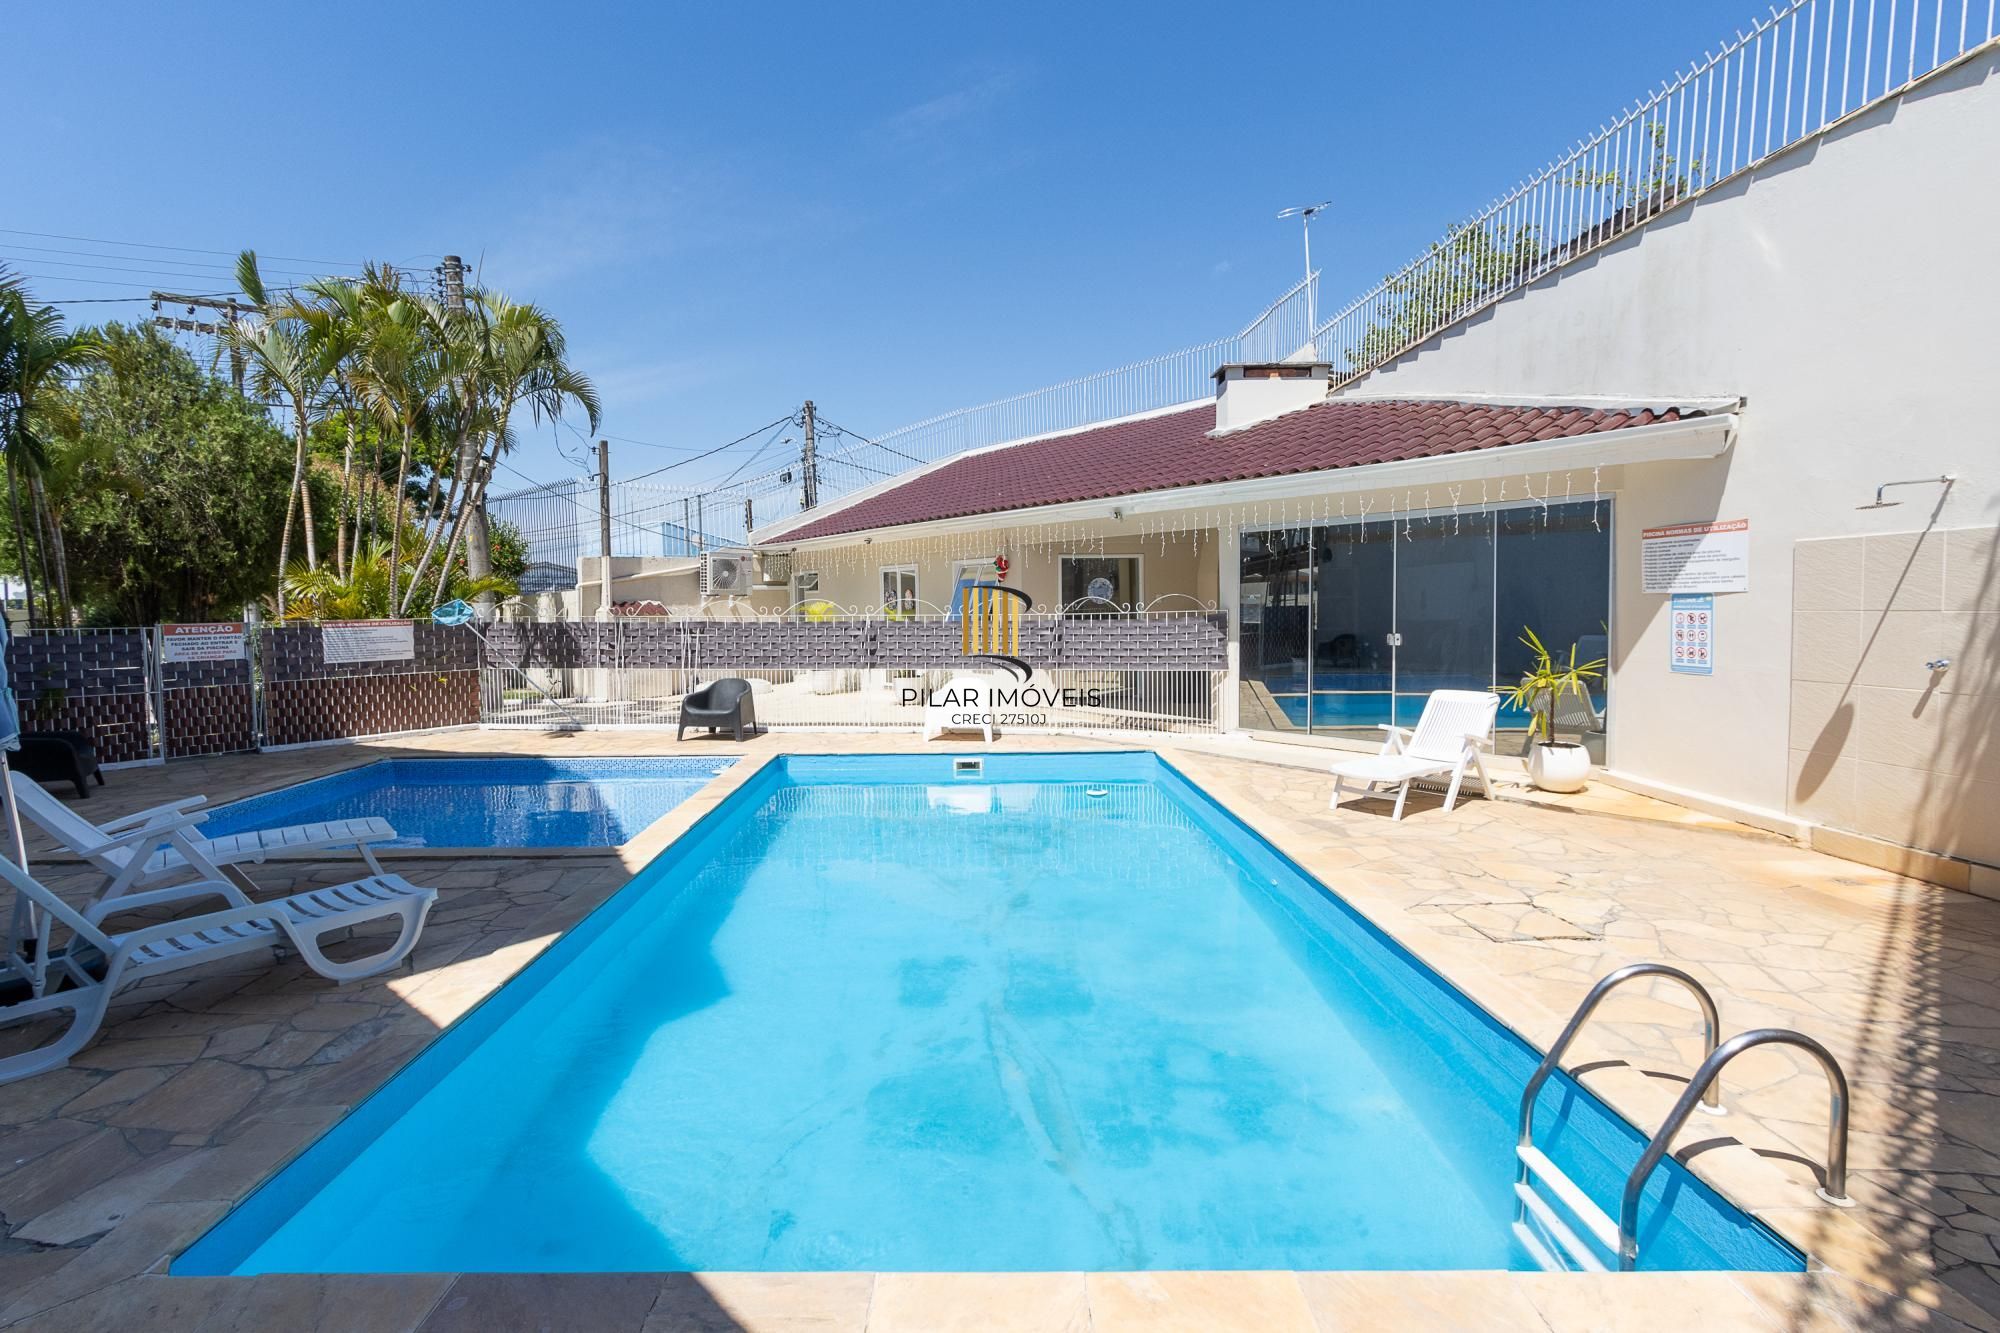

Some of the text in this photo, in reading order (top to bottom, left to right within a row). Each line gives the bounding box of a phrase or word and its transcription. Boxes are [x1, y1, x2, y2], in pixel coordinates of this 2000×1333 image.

[1665, 528, 1692, 536] NORMAS
[1703, 522, 1747, 532] UTILIZAÇÃO
[175, 625, 234, 634] ATENÇÃO
